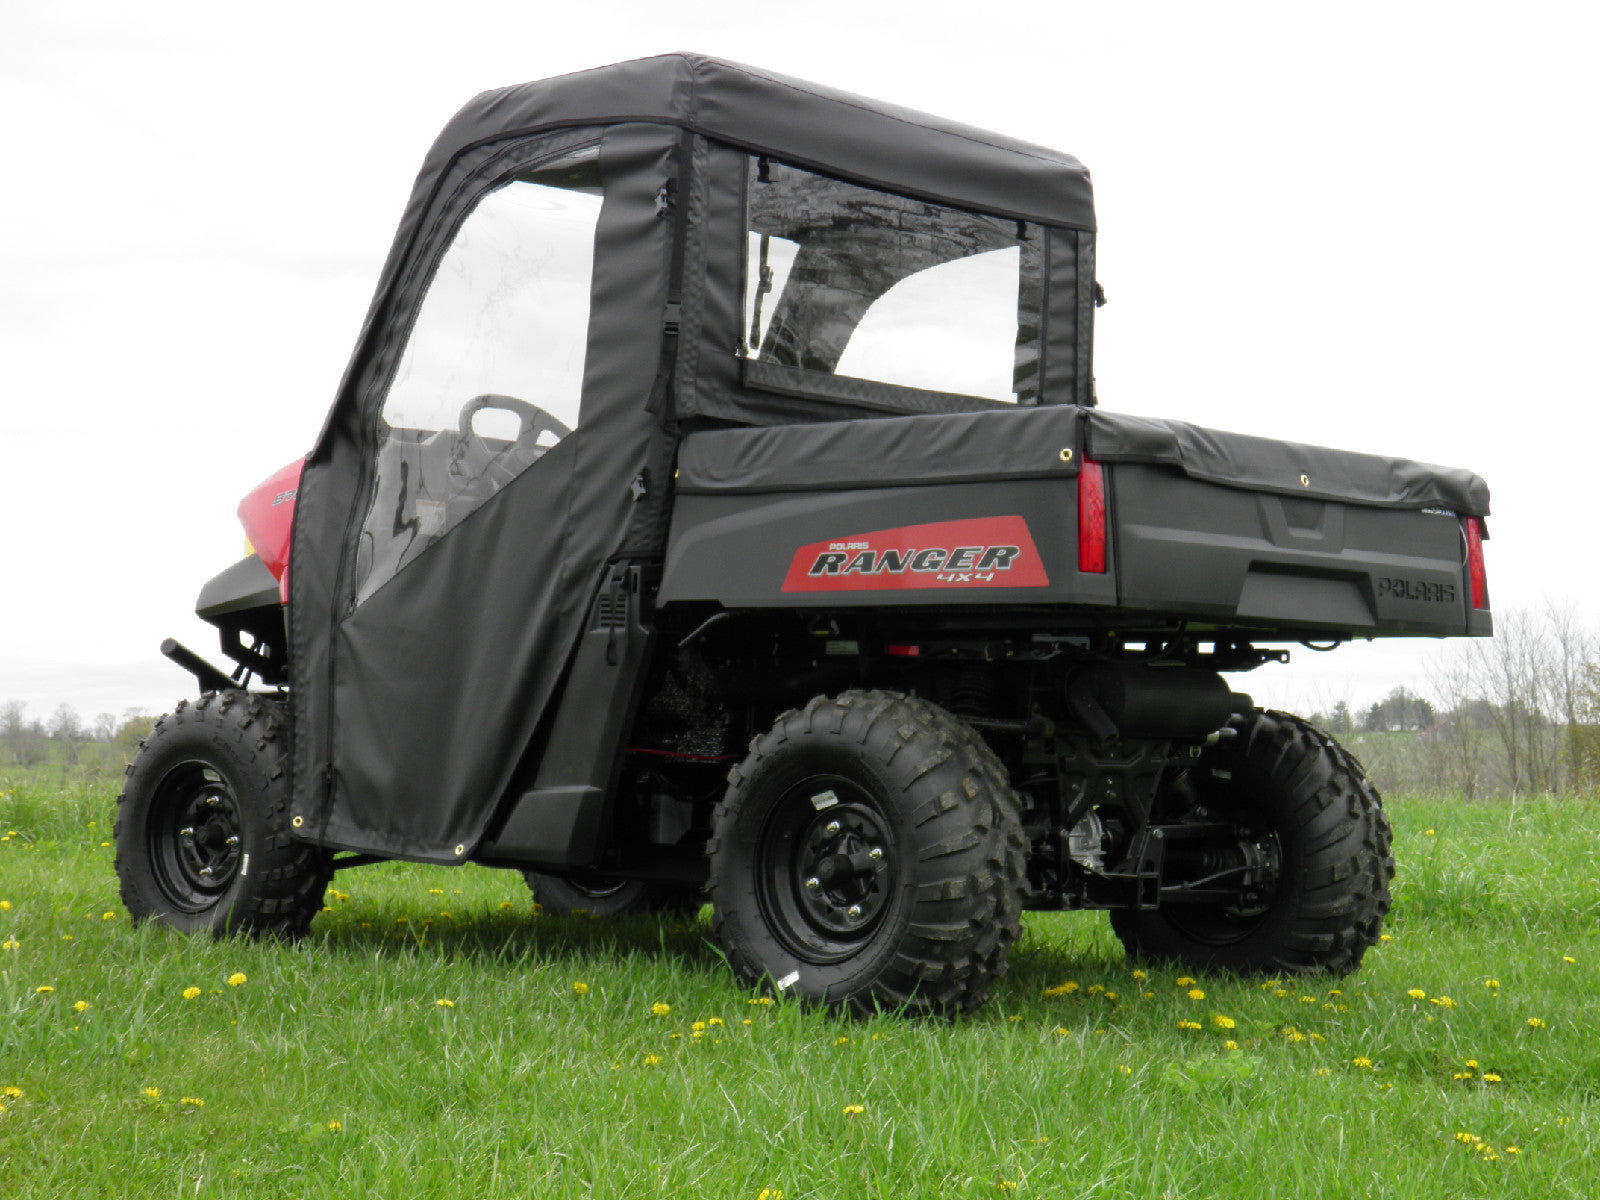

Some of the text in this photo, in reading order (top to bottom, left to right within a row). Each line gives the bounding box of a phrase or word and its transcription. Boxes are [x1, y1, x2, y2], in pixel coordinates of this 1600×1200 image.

[829, 542, 869, 550] POLARIS
[807, 545, 1021, 576] RANGER
[1379, 577, 1455, 602] POLARIS
